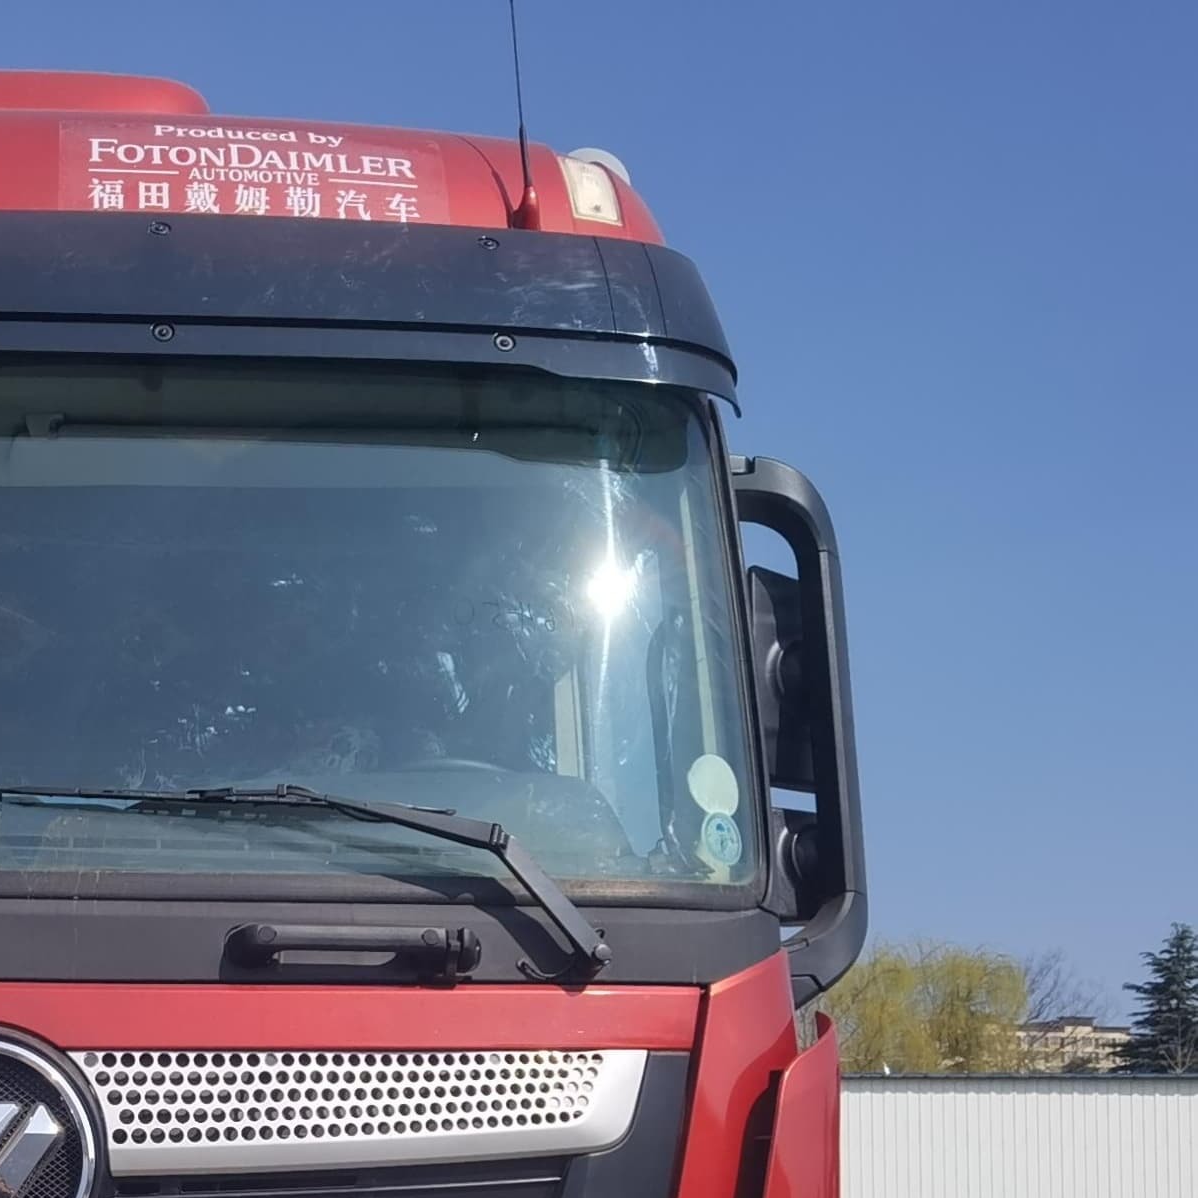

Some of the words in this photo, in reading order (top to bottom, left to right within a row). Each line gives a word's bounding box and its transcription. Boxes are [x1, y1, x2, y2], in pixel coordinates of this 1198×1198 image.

[154, 125, 298, 143] Produced
[308, 132, 343, 148] by
[188, 167, 320, 187] AUTOMOTIVE
[88, 179, 421, 222] 福田戴姆勒汽车
